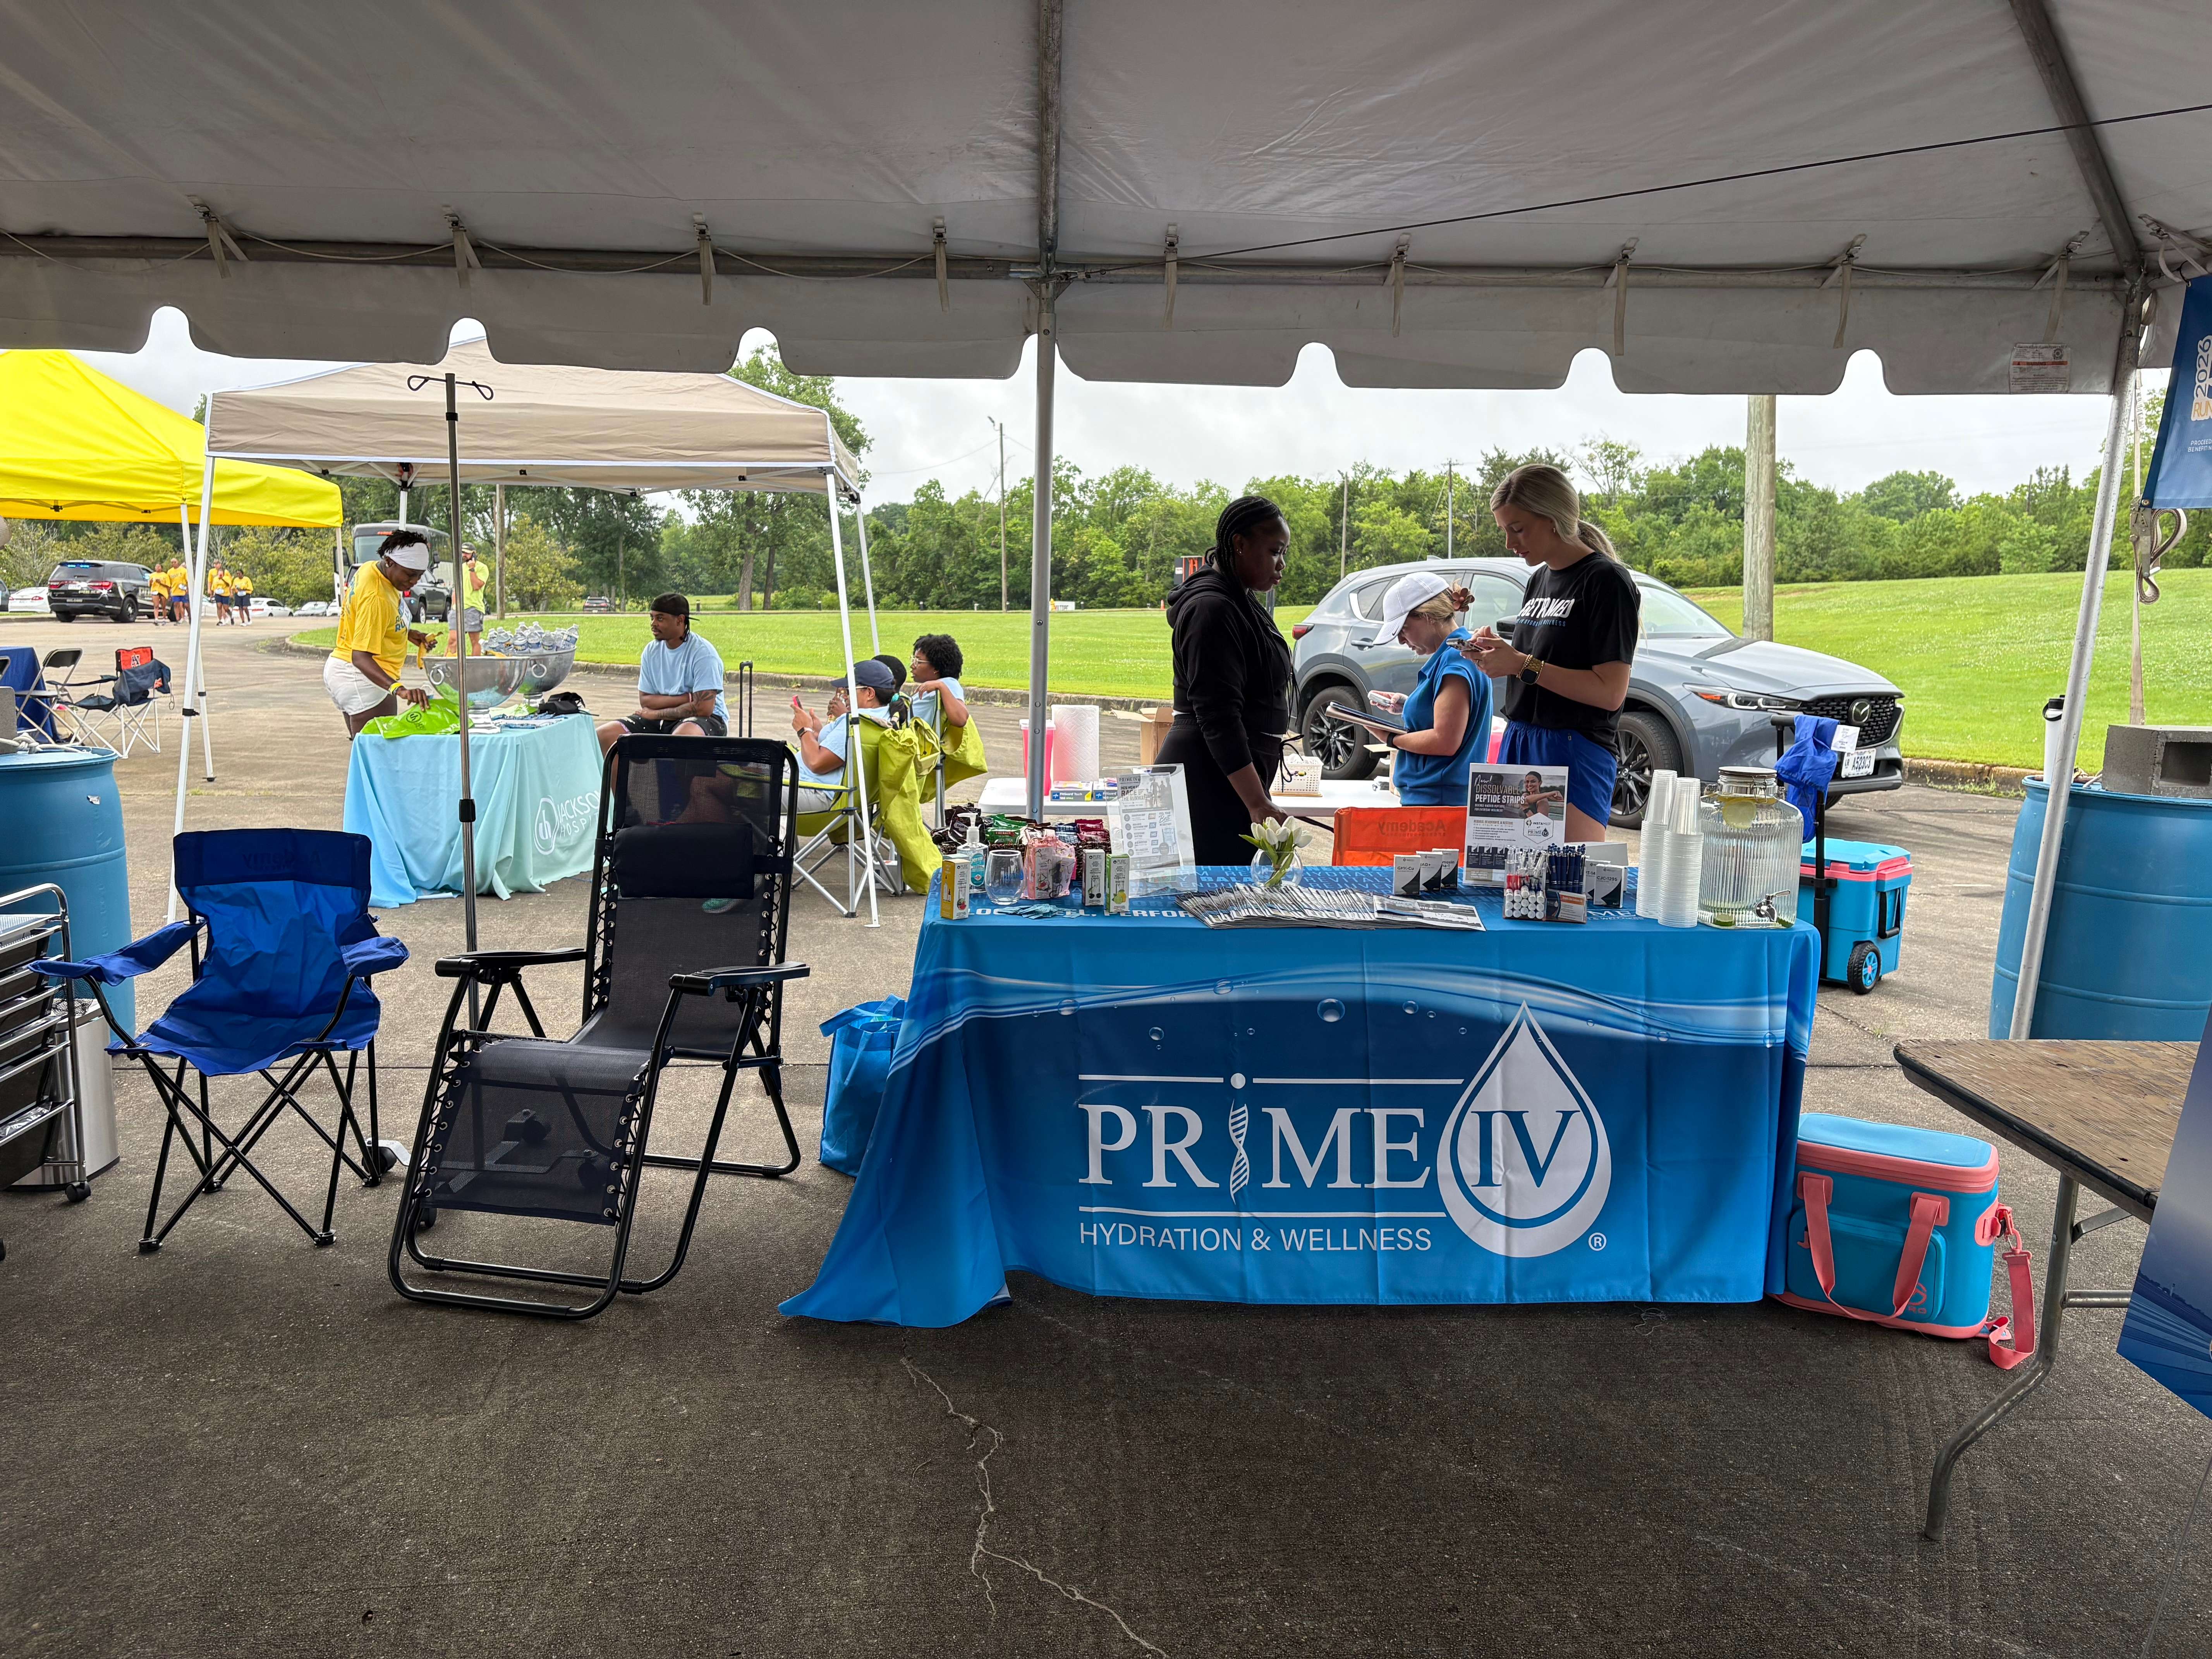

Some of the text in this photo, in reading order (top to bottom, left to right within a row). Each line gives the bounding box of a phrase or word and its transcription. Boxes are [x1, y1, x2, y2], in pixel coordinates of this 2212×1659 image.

[2195, 338, 2211, 398] 2026
[1851, 755, 1872, 771] A523C3
[1474, 775, 1492, 787] New!
[1475, 784, 1520, 795] DISSOLVABLE
[1475, 794, 1525, 804] PEPTIDE STRIPS
[560, 813, 598, 837] HOSPIT
[1078, 1098, 1581, 1205] PRIME IV
[1079, 1222, 1241, 1251] HYDRATION
[1251, 1227, 1271, 1251] &
[1280, 1228, 1432, 1251] WELLNESS
